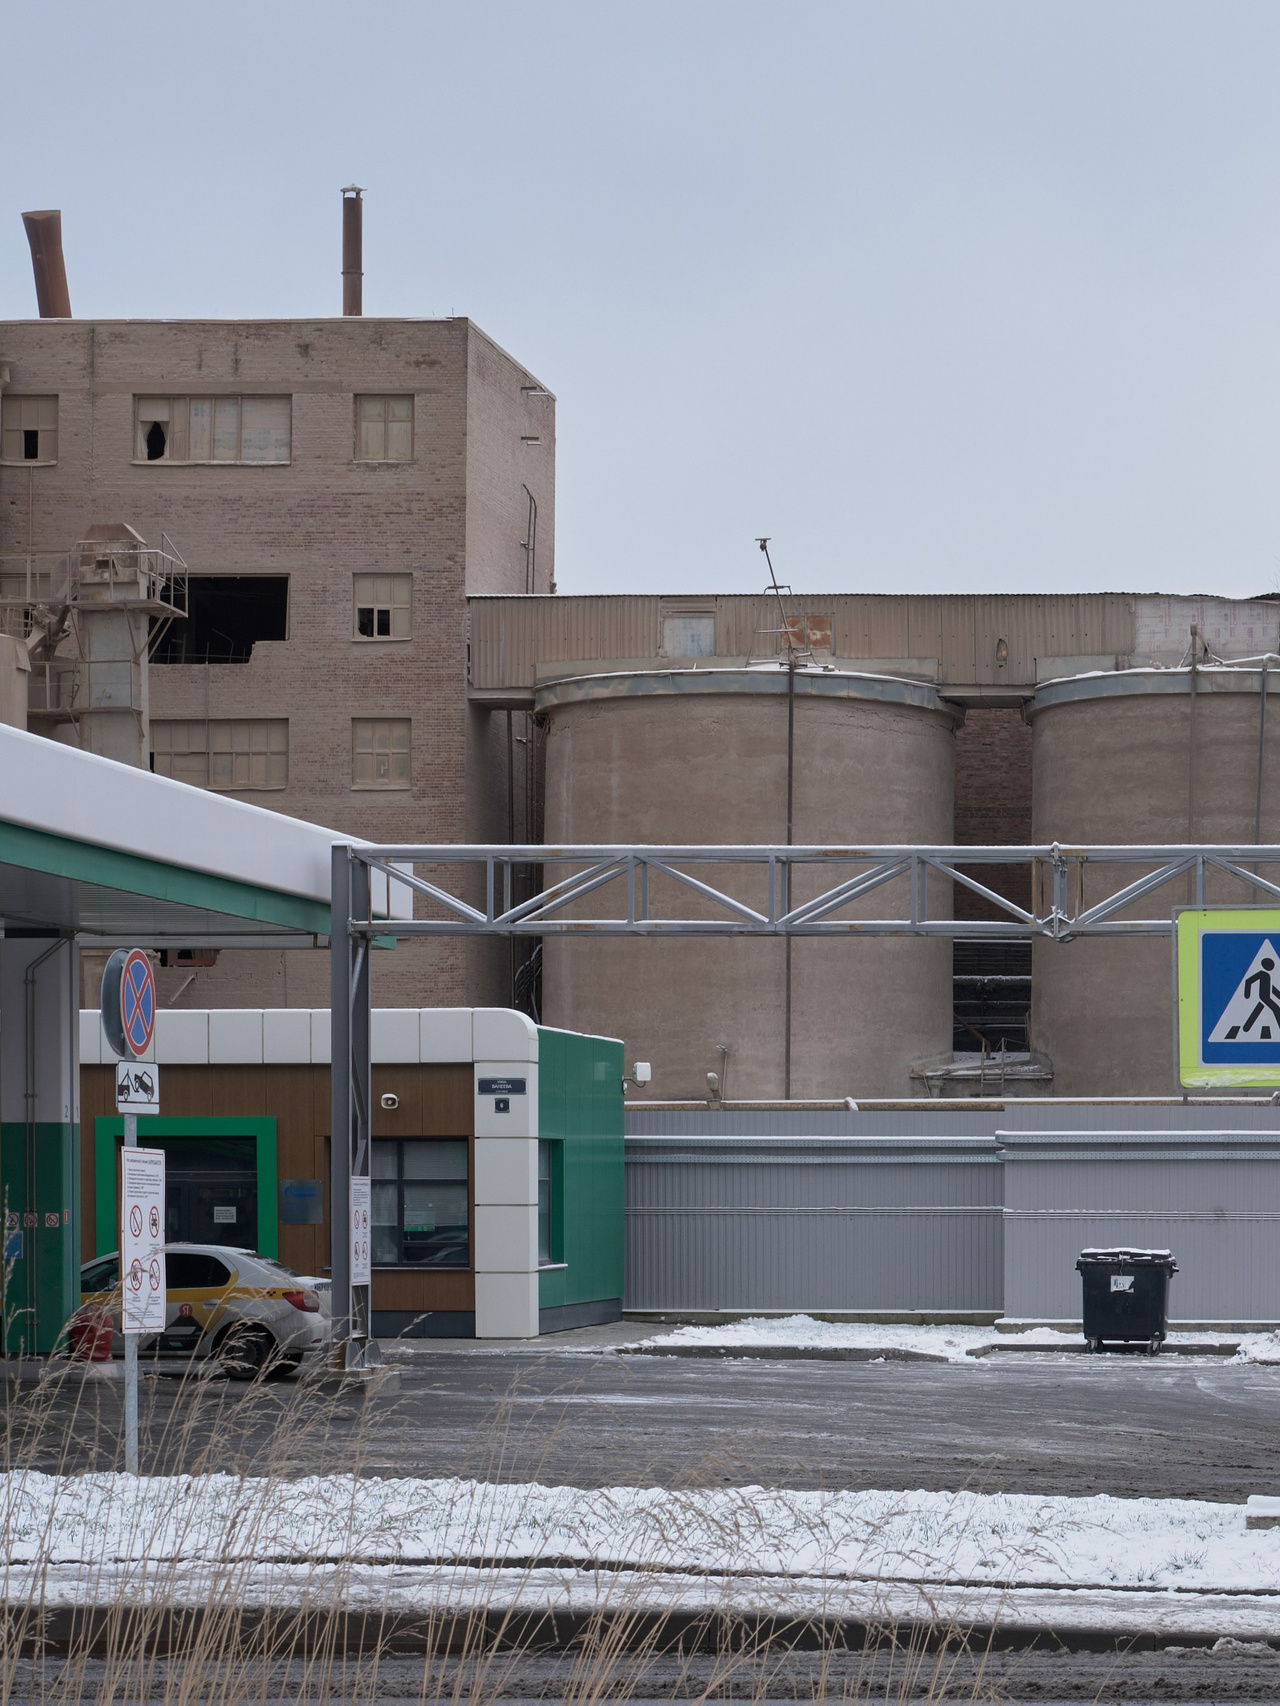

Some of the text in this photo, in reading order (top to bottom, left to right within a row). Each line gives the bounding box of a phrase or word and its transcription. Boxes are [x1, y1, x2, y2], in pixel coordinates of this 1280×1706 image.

[64, 1104, 68, 1118] 2
[76, 1105, 78, 1118] 1
[182, 1306, 189, 1314] Я
